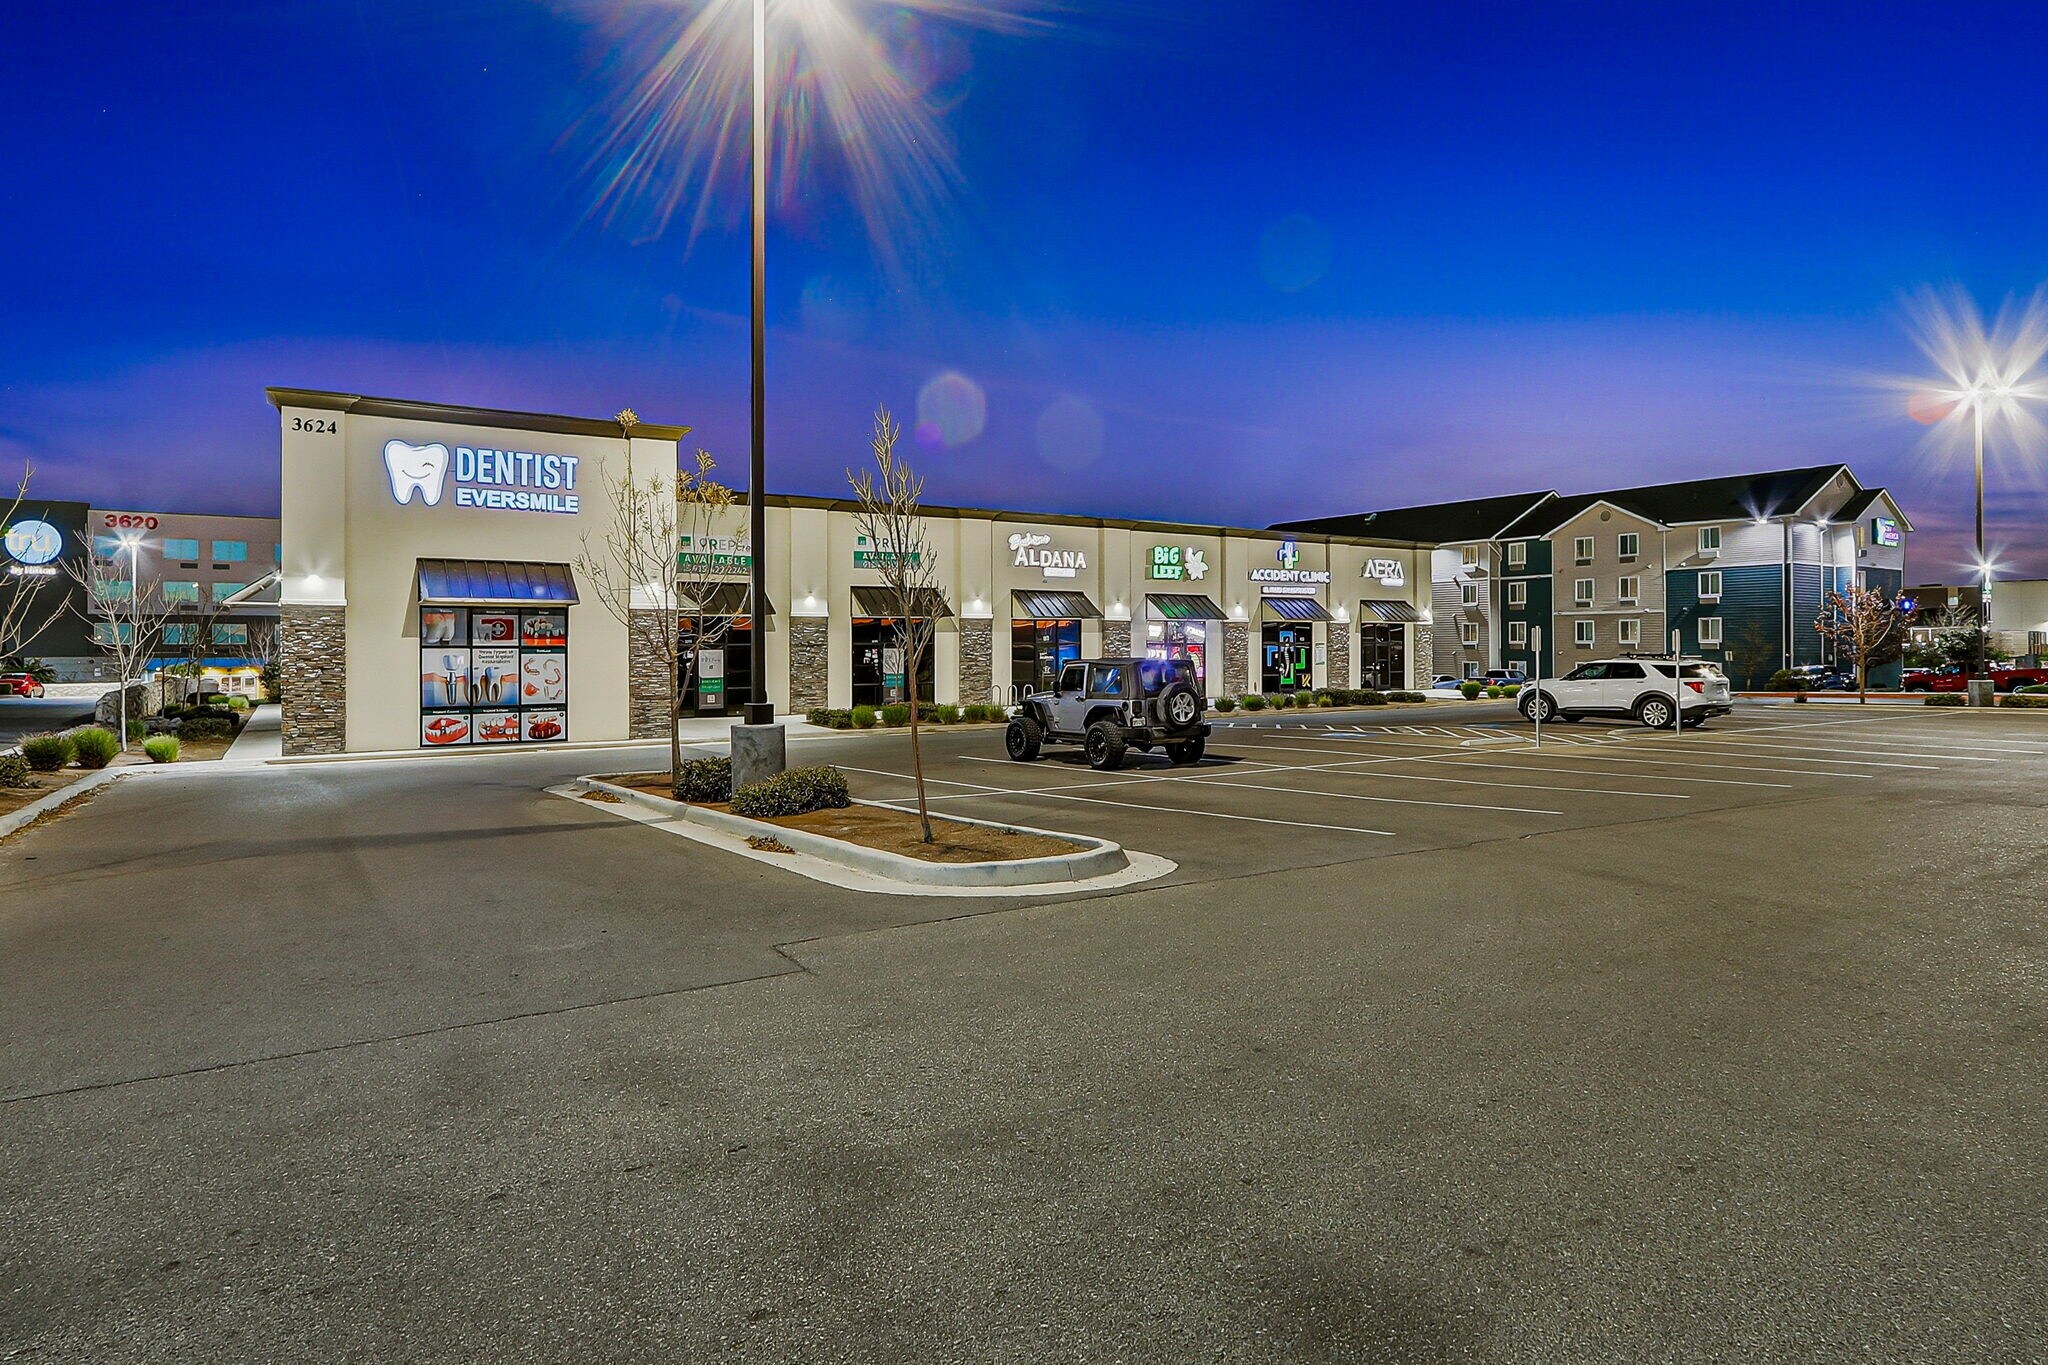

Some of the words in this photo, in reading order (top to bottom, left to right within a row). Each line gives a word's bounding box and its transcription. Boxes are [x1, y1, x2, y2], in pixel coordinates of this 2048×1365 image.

[291, 417, 337, 435] 3624
[455, 446, 579, 491] DENTIST
[455, 487, 580, 514] EVERSMILE
[104, 514, 159, 530] 3620
[1014, 546, 1087, 569] ALDANA
[1250, 568, 1300, 582] ACCIDENT
[1300, 571, 1331, 583] CLINIC
